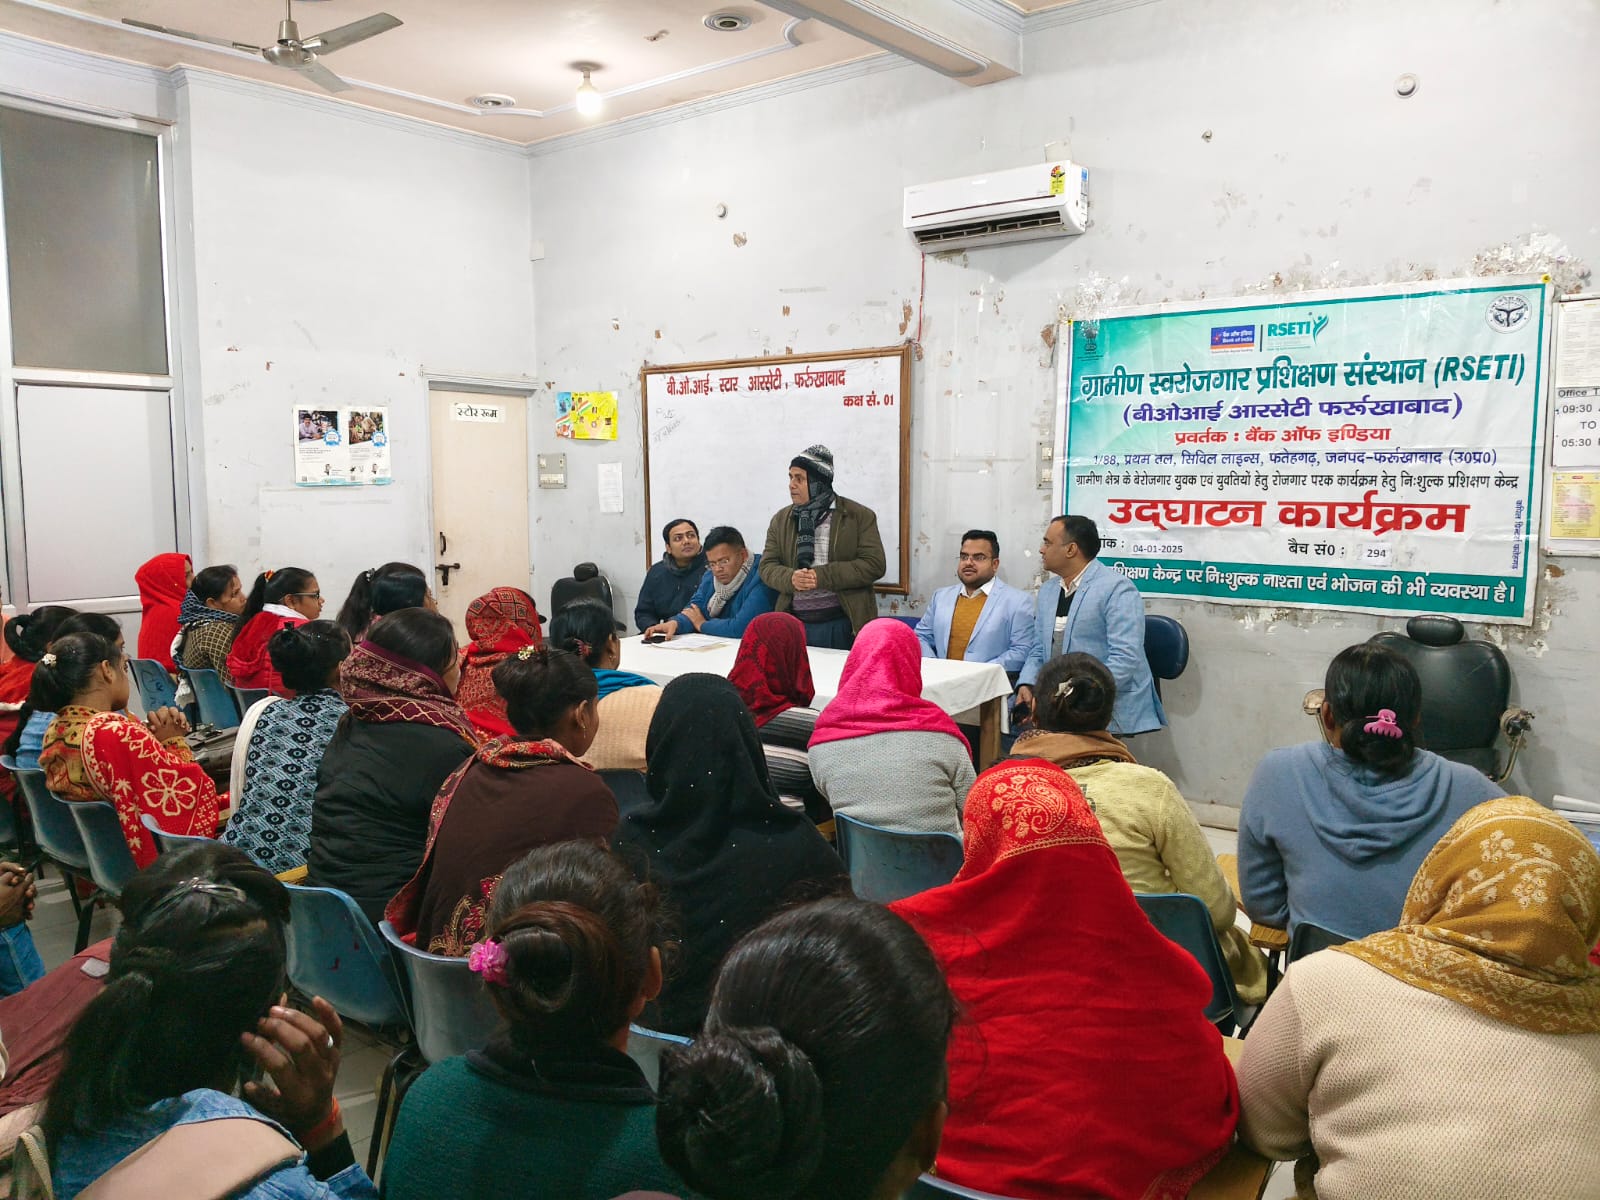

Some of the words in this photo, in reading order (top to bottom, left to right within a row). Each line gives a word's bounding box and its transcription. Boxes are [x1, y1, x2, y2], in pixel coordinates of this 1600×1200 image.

[1268, 321, 1311, 337] RSETI
[1082, 366, 1144, 401] ग्रामीण
[1149, 362, 1252, 396] स्वरोजगार
[1256, 355, 1338, 394] प्रशिक्षण
[1344, 352, 1426, 387] संस्थान
[1434, 353, 1525, 389] (RSETI)
[719, 377, 739, 393] स्टार
[843, 395, 864, 407] कक्ष
[884, 393, 894, 406] 01
[1558, 389, 1587, 398] Office
[1123, 400, 1224, 427] (बीओआई
[1228, 397, 1312, 419] आरसेटी
[1562, 403, 1592, 414] 09:30
[1579, 420, 1597, 430] TO
[1175, 427, 1228, 446] प्रवर्तक
[1245, 425, 1277, 442] बैंक
[1281, 425, 1322, 442] ऑफ
[1327, 424, 1392, 443] इण्डिया
[1561, 438, 1592, 447] 05:30
[1125, 454, 1151, 465] प्रथम
[1181, 450, 1218, 464] सिविल
[1076, 470, 1102, 485] ग्रामीण
[1105, 470, 1120, 486] क्षेत्र
[1122, 470, 1132, 485] के
[1133, 470, 1172, 486] बेरोजगार
[1174, 474, 1198, 490] युवक
[1200, 471, 1213, 486] एवं
[1216, 470, 1251, 490] युवतियों
[1254, 470, 1269, 490] हेतु
[1272, 470, 1307, 486] रोजगार
[1311, 475, 1333, 486] परक
[1337, 469, 1378, 487] कार्यक्रम
[1381, 470, 1396, 492] हेतु
[1448, 470, 1490, 488] प्रशिक्षण
[1494, 470, 1519, 489] केन्द्र
[1278, 489, 1471, 536] कार्यक्रम
[1133, 544, 1183, 553] 04-01-2025
[1288, 538, 1309, 555] बैच
[1367, 549, 1386, 558] 294
[1152, 563, 1183, 584] केन्द्र
[1186, 567, 1203, 583] पर
[1262, 573, 1303, 590] नाश्ता
[1307, 572, 1328, 591] एवं
[1331, 573, 1377, 594] भोजन
[1381, 573, 1402, 596] की
[1406, 574, 1426, 597] भी
[1430, 583, 1490, 601] व्यवस्था
